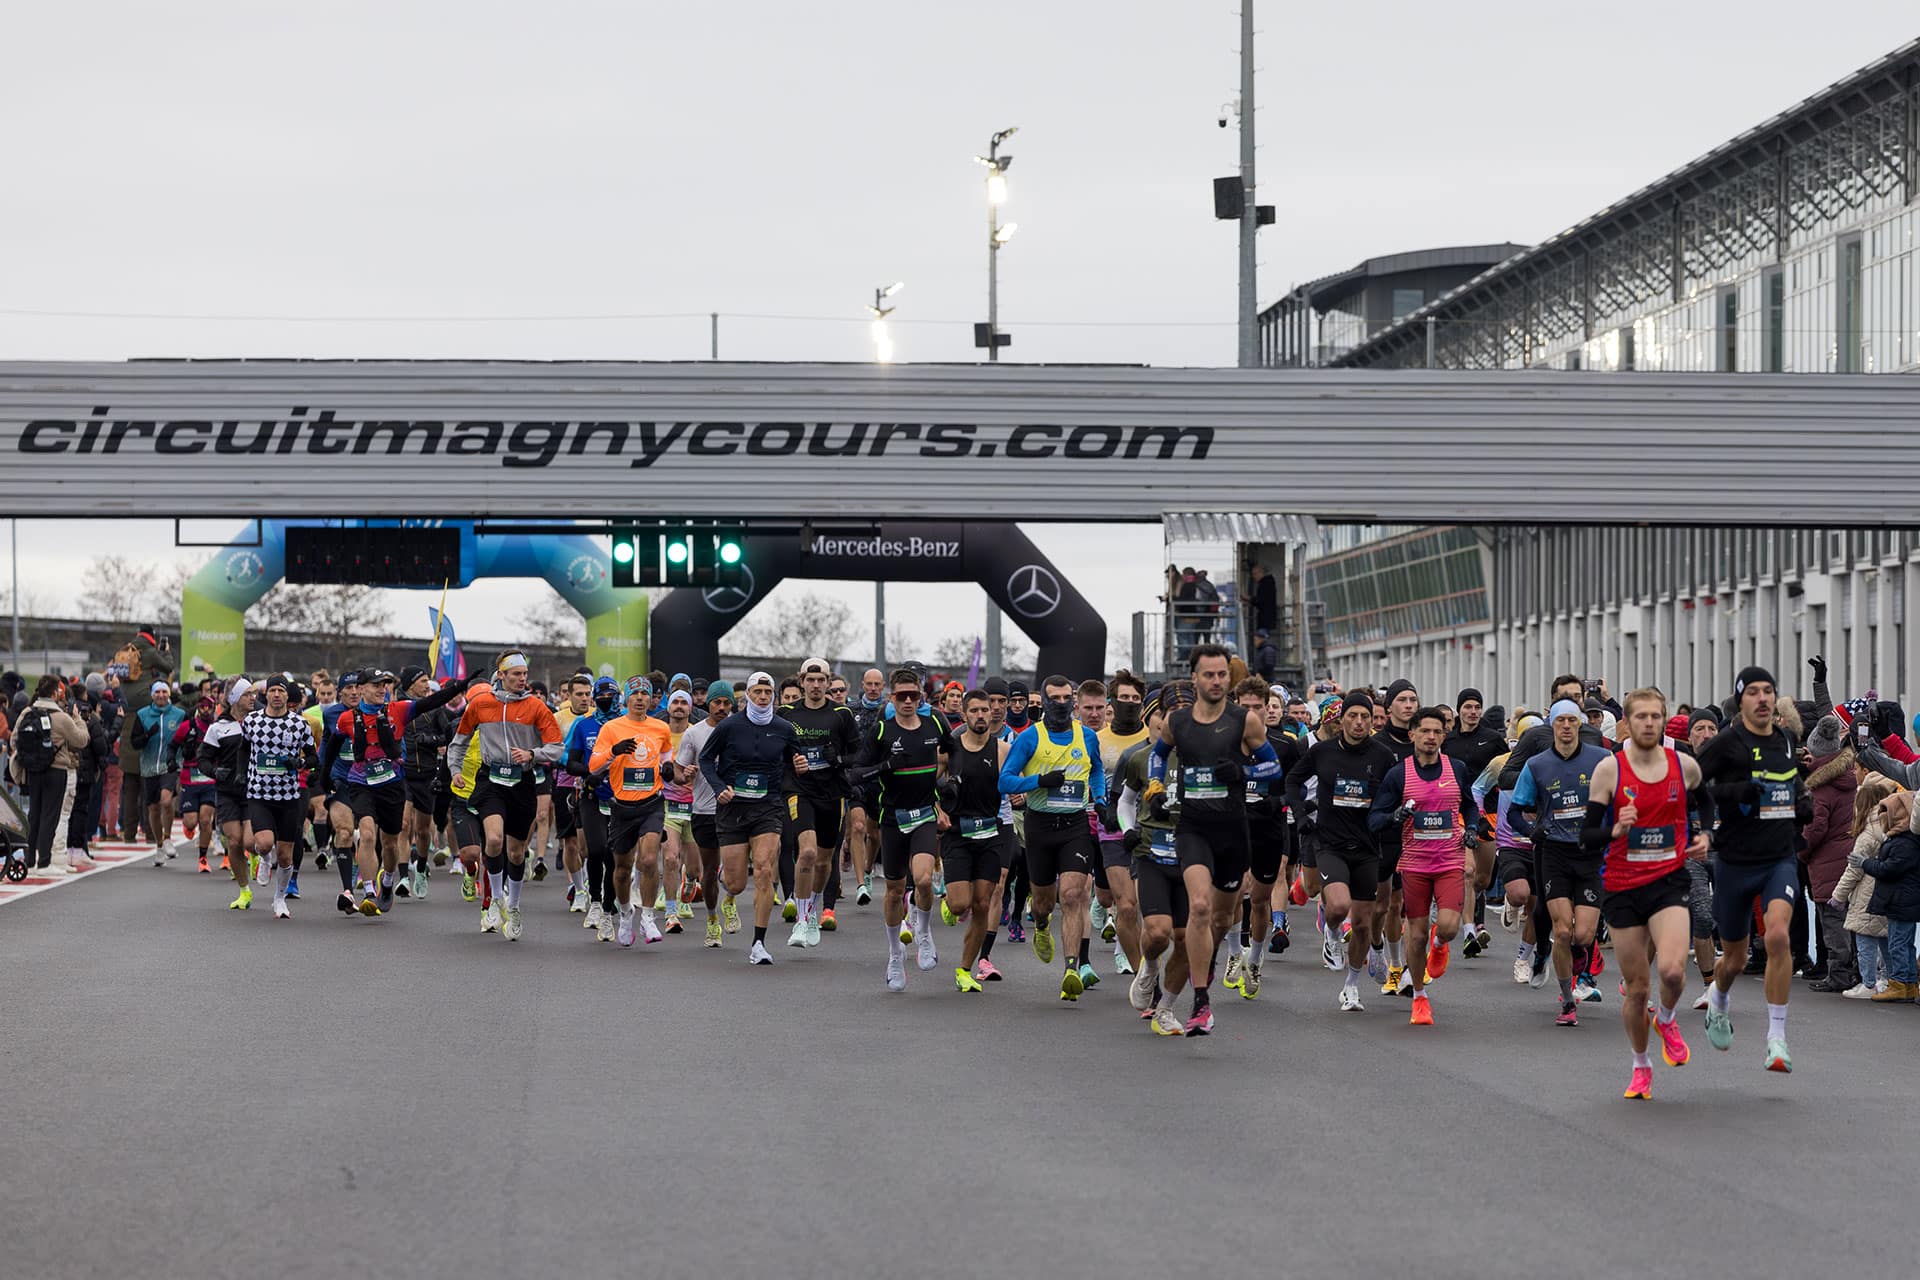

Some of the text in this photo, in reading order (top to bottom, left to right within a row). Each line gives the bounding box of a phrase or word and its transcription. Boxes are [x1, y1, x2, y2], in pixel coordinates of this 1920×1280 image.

[18, 406, 1214, 467] circuitmagnycours.com
[811, 536, 960, 558] Mercedes-Benz
[1246, 781, 1257, 790] 177
[1641, 834, 1664, 845] 2232
